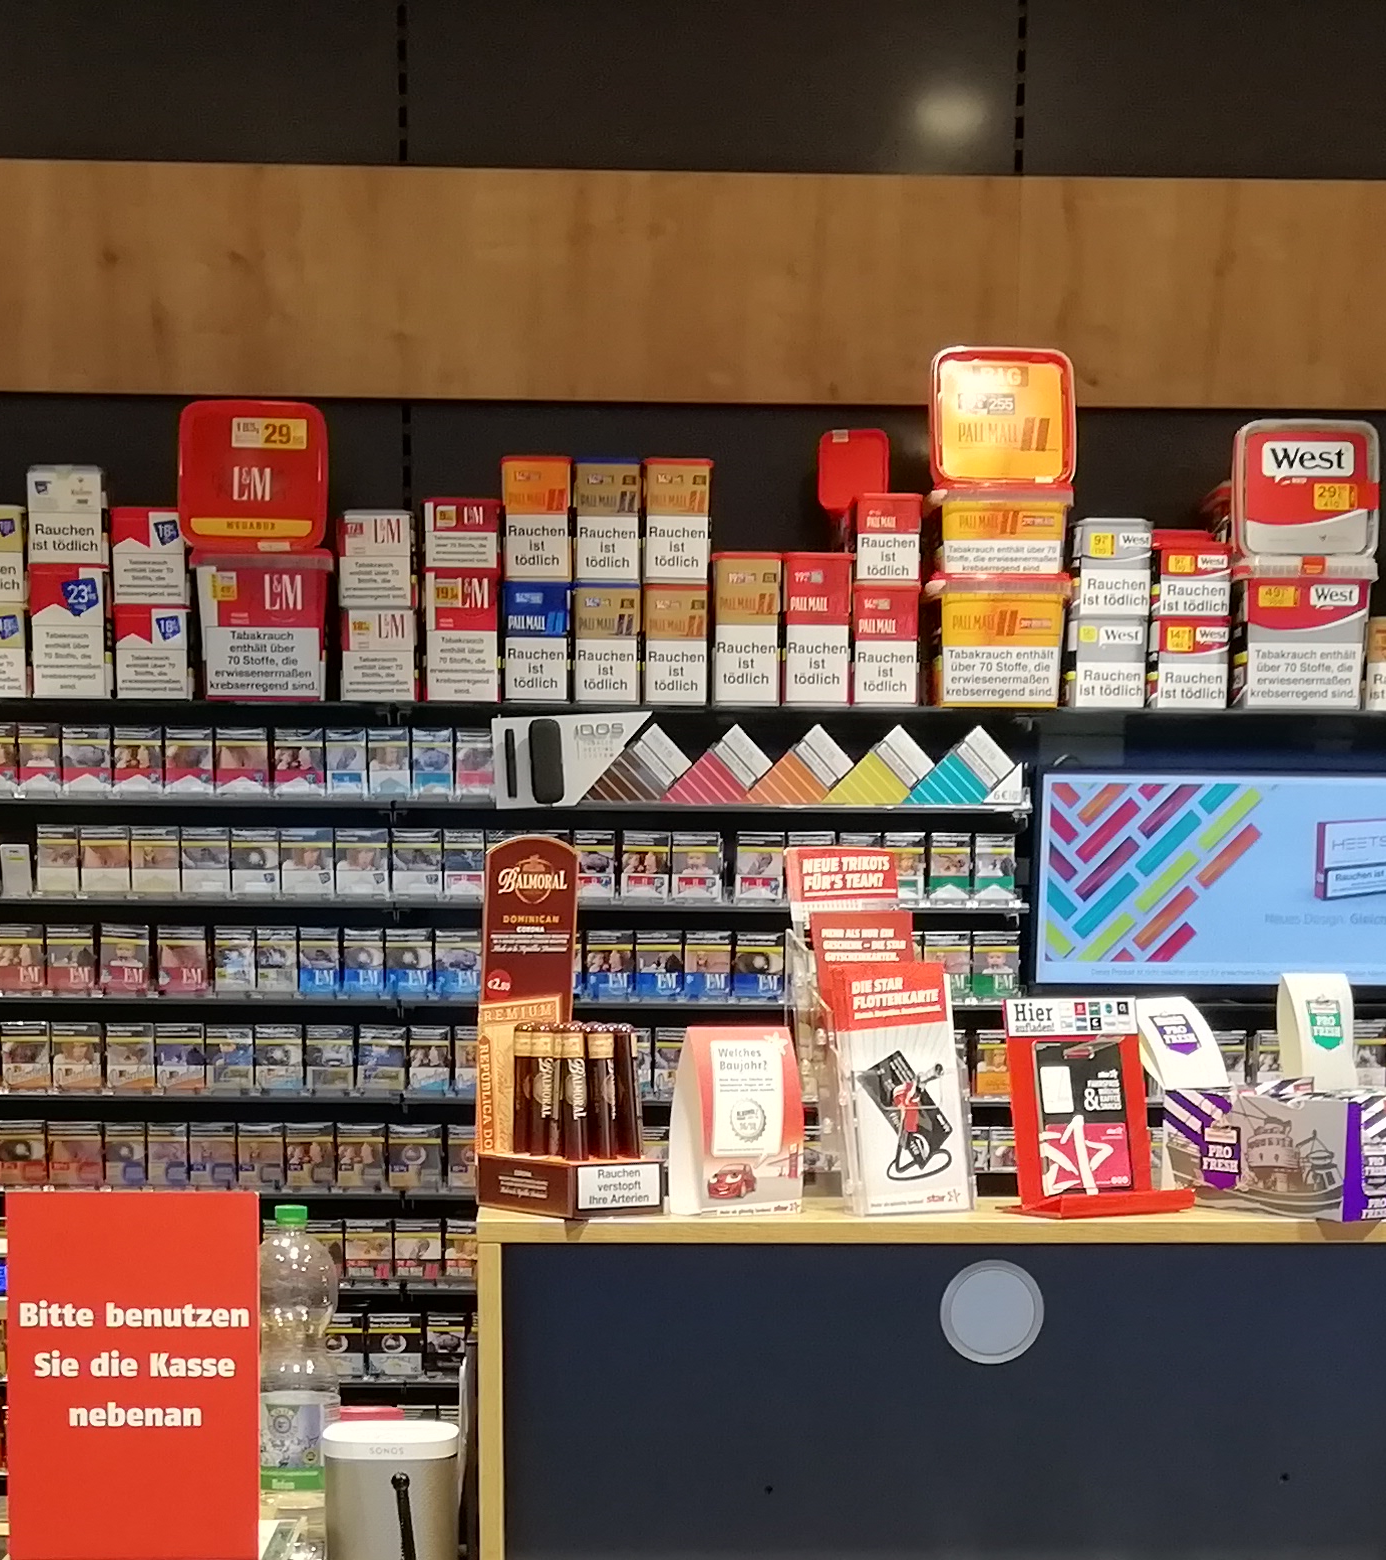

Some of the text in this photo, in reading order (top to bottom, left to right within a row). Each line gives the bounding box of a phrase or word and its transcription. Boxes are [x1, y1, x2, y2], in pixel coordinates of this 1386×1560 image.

[264, 424, 291, 443] 29
[1270, 447, 1345, 469] West
[233, 467, 270, 501] L&M
[35, 525, 94, 536] Rauchen
[374, 519, 401, 543] L&M
[509, 526, 565, 537] Rauchen
[33, 539, 98, 551] ist tödlich
[530, 540, 545, 551] ist
[861, 538, 915, 549] Rauchen
[1122, 534, 1150, 545] West
[515, 555, 559, 566] tödlich
[881, 552, 896, 562] ist
[867, 565, 909, 576] tödlich
[1087, 579, 1146, 590] Rauchen
[265, 574, 301, 610] L&M
[1315, 589, 1354, 602] West
[1083, 594, 1148, 606] ist tödlich
[508, 616, 545, 629] PALL MALL
[858, 619, 896, 633] PALL MALL
[1104, 630, 1139, 641] West
[948, 650, 1054, 660] Tabakrauch enthält
[951, 662, 977, 672] über
[980, 663, 993, 672] 70
[1035, 662, 1051, 671] die
[951, 674, 1049, 684] erwiesenermaßen
[946, 686, 1025, 698] krebserregend
[803, 856, 890, 873] NEUE TRIKOTS
[498, 867, 567, 894] BALMORAL
[804, 873, 884, 890] FÜR'S TEAM?
[503, 915, 559, 924] DOMINICAN
[852, 977, 903, 992] DIE STAR
[853, 989, 939, 1009] FLOTTENKARTE
[1015, 1003, 1053, 1021] Hier
[1015, 1023, 1055, 1032] aufladen!
[1163, 1026, 1187, 1034] PRO
[719, 1048, 762, 1058] Welches
[719, 1059, 768, 1071] Baujahr?
[1208, 1145, 1232, 1158] PRO
[1203, 1159, 1238, 1173] FRESH
[598, 1169, 641, 1180] Rauchen
[598, 1181, 641, 1194] verstopft
[589, 1193, 649, 1205] Ihre Arterien
[20, 1301, 249, 1328] Bitte benutzen
[34, 1350, 235, 1377] Sie die Kasse
[70, 1402, 201, 1427] nebenan
[369, 1447, 405, 1455] SONOS
